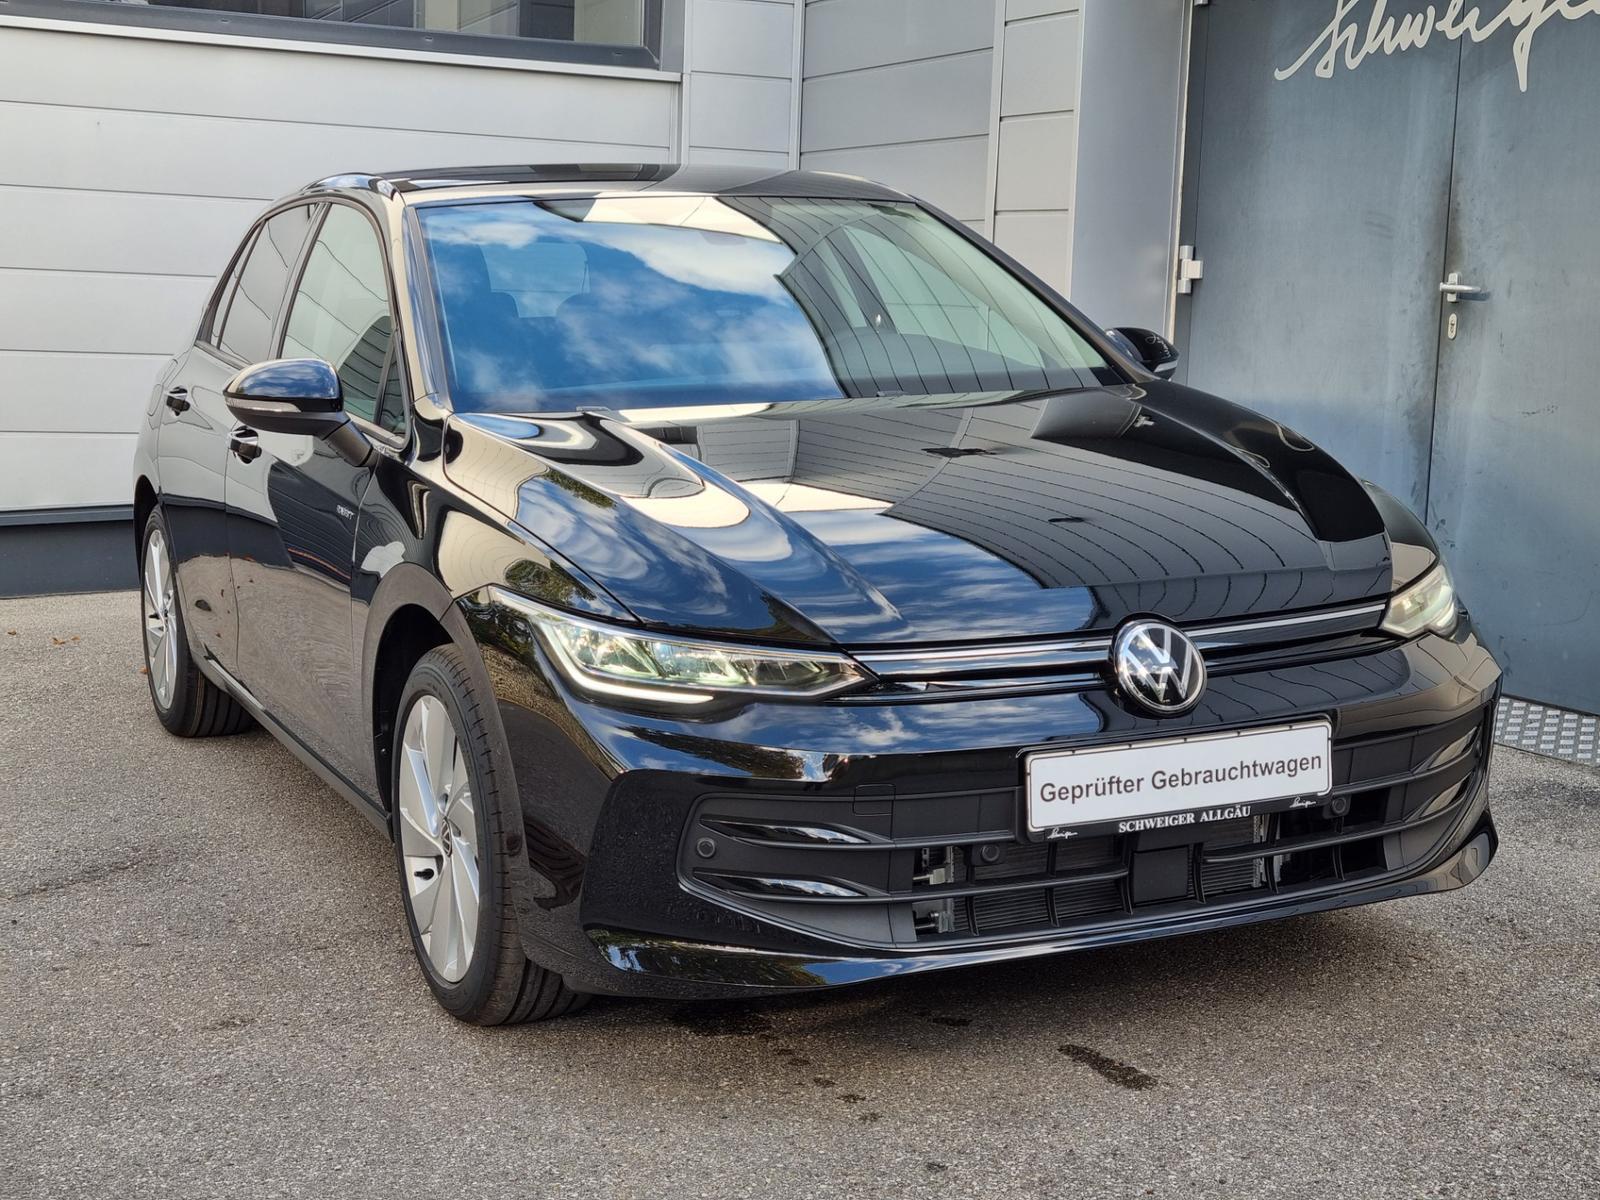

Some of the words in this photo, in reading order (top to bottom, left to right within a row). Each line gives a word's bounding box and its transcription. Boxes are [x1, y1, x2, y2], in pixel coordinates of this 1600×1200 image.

[1040, 777, 1145, 804] Geprüfter
[1151, 755, 1322, 790] Gebrauchtwagen
[1118, 812, 1195, 833] SCHWEIGER
[1200, 804, 1251, 822] ALLGÄU
